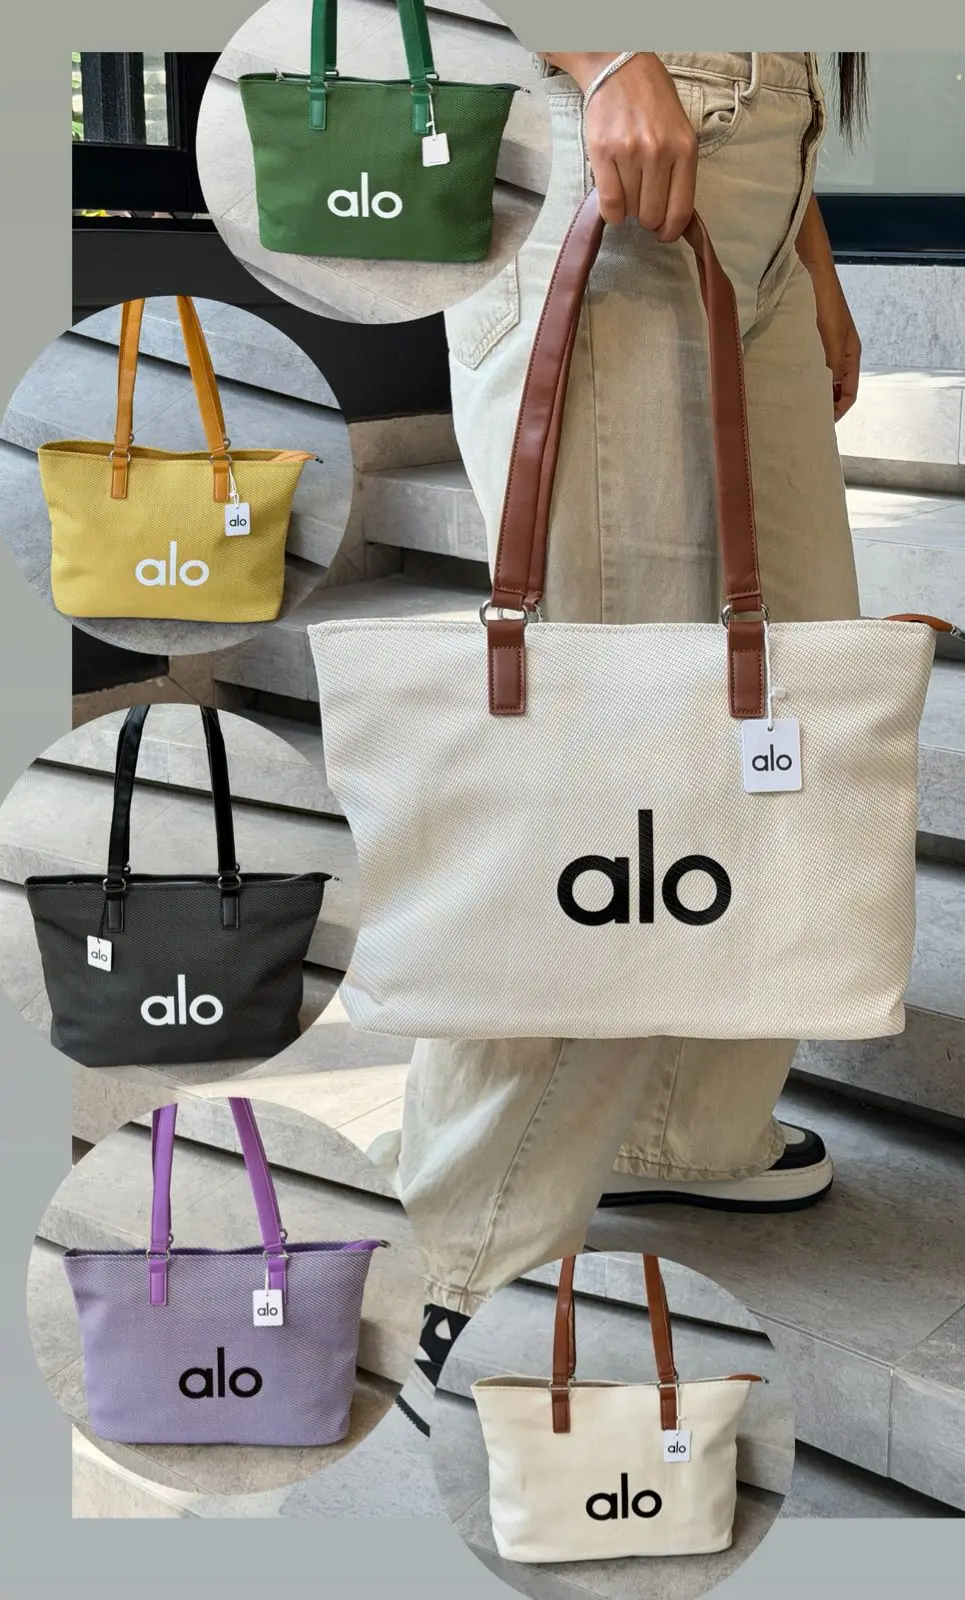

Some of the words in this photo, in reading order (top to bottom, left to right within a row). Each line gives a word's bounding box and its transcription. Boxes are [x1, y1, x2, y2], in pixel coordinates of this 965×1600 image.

[327, 172, 403, 219] alo
[229, 514, 247, 527] alo
[135, 541, 209, 587] alo
[752, 744, 792, 771] alo
[557, 809, 732, 927] alo
[91, 948, 108, 962] alo
[141, 974, 223, 1026] alo
[257, 1302, 278, 1317] alo
[179, 1347, 263, 1400] alo
[667, 1440, 687, 1454] alo
[586, 1473, 662, 1521] alo
